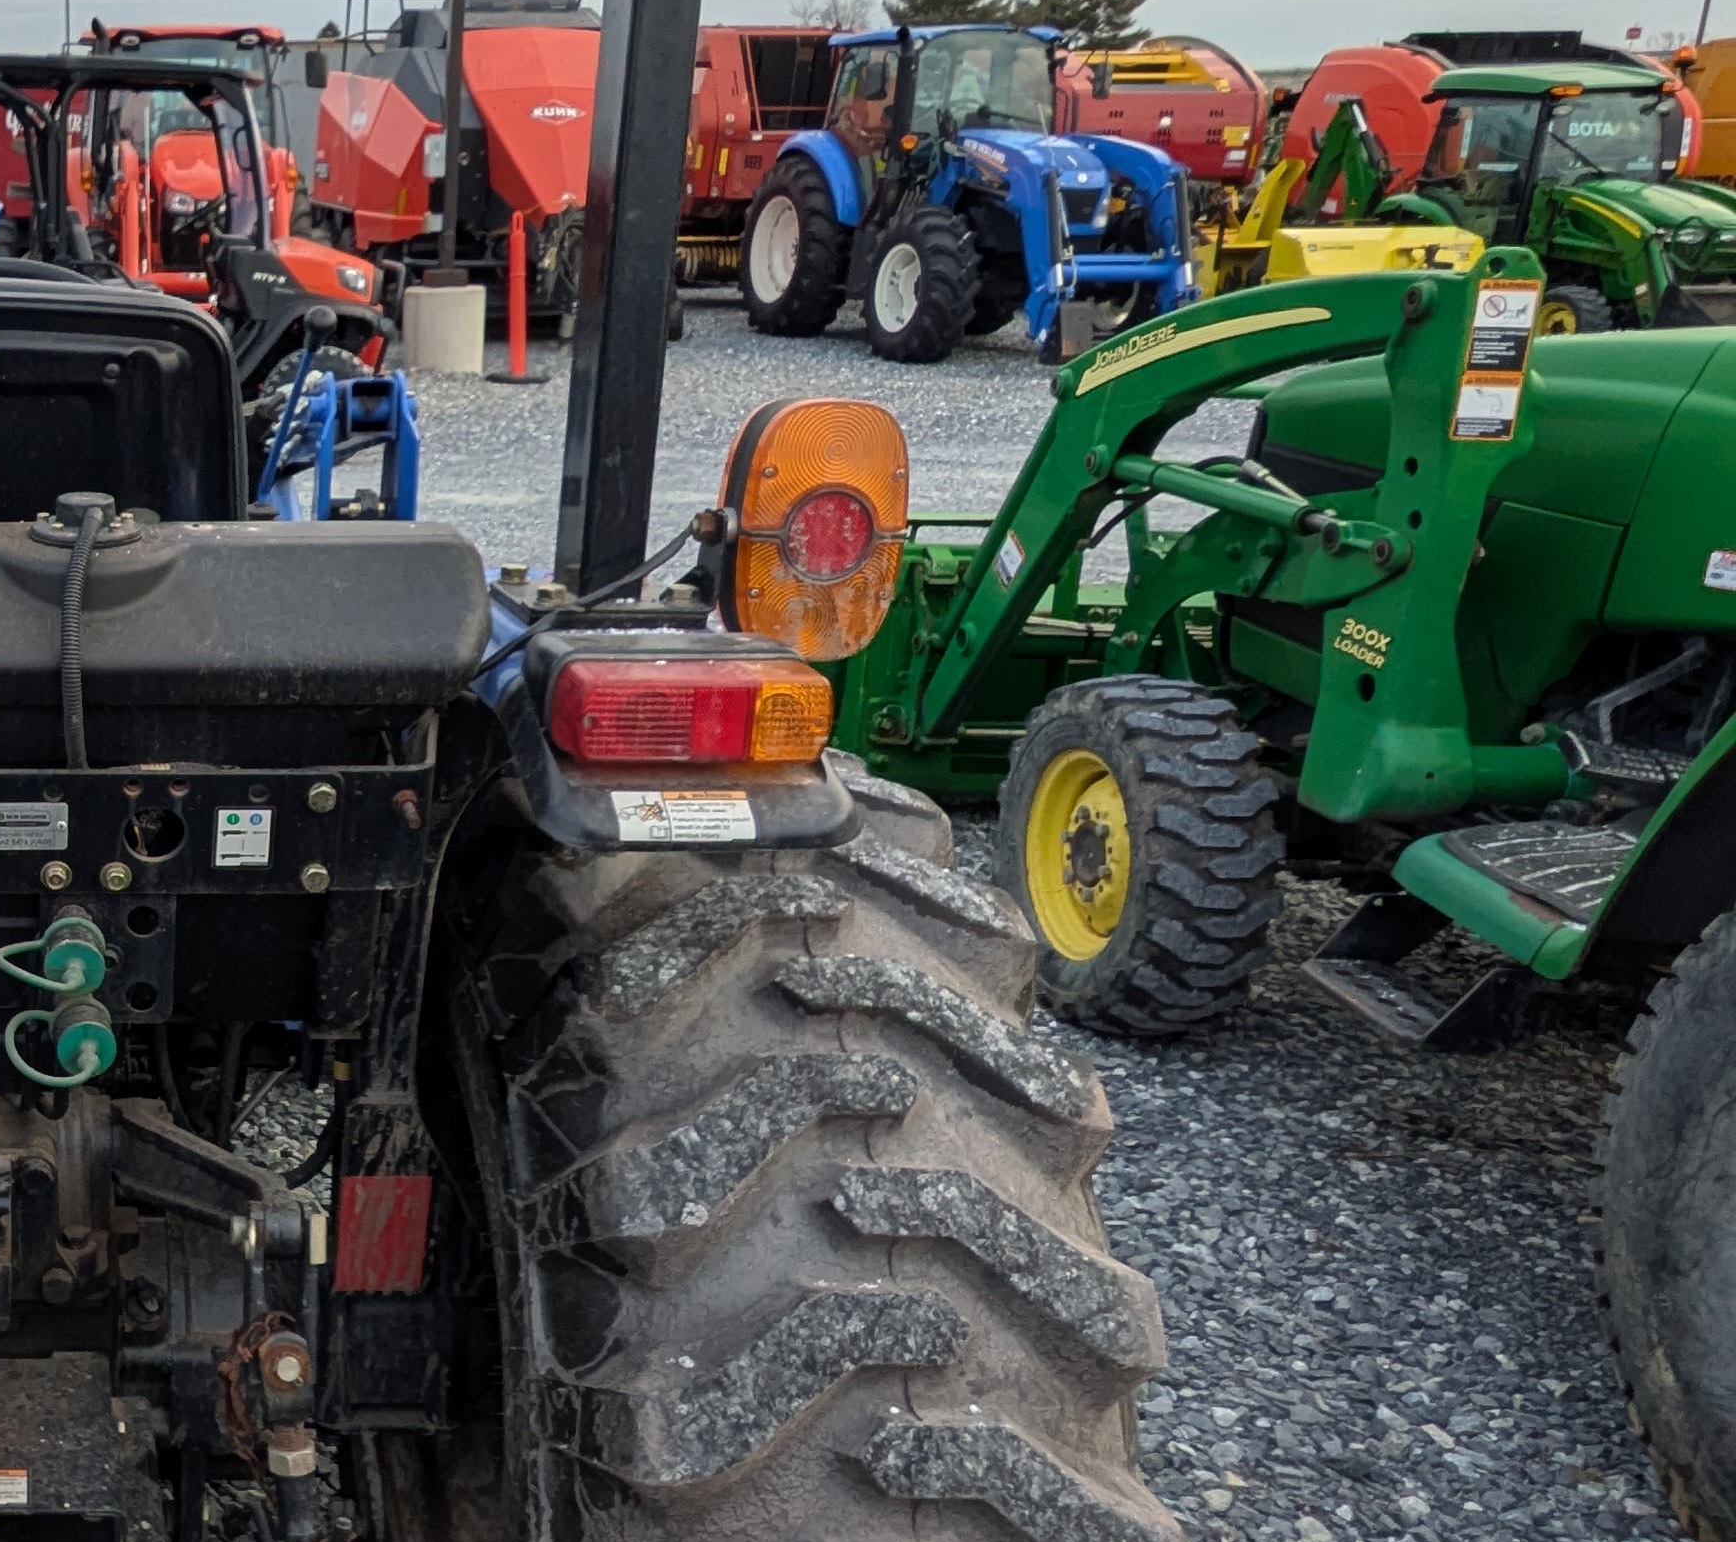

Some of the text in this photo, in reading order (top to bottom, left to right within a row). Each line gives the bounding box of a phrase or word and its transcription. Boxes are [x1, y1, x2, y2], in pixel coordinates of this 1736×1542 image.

[533, 106, 577, 118] KUHN
[1568, 121, 1614, 137] BOTA
[1090, 322, 1178, 373] JOHN DEERE
[1333, 635, 1385, 669] LOADER
[1340, 618, 1392, 652] 300X
